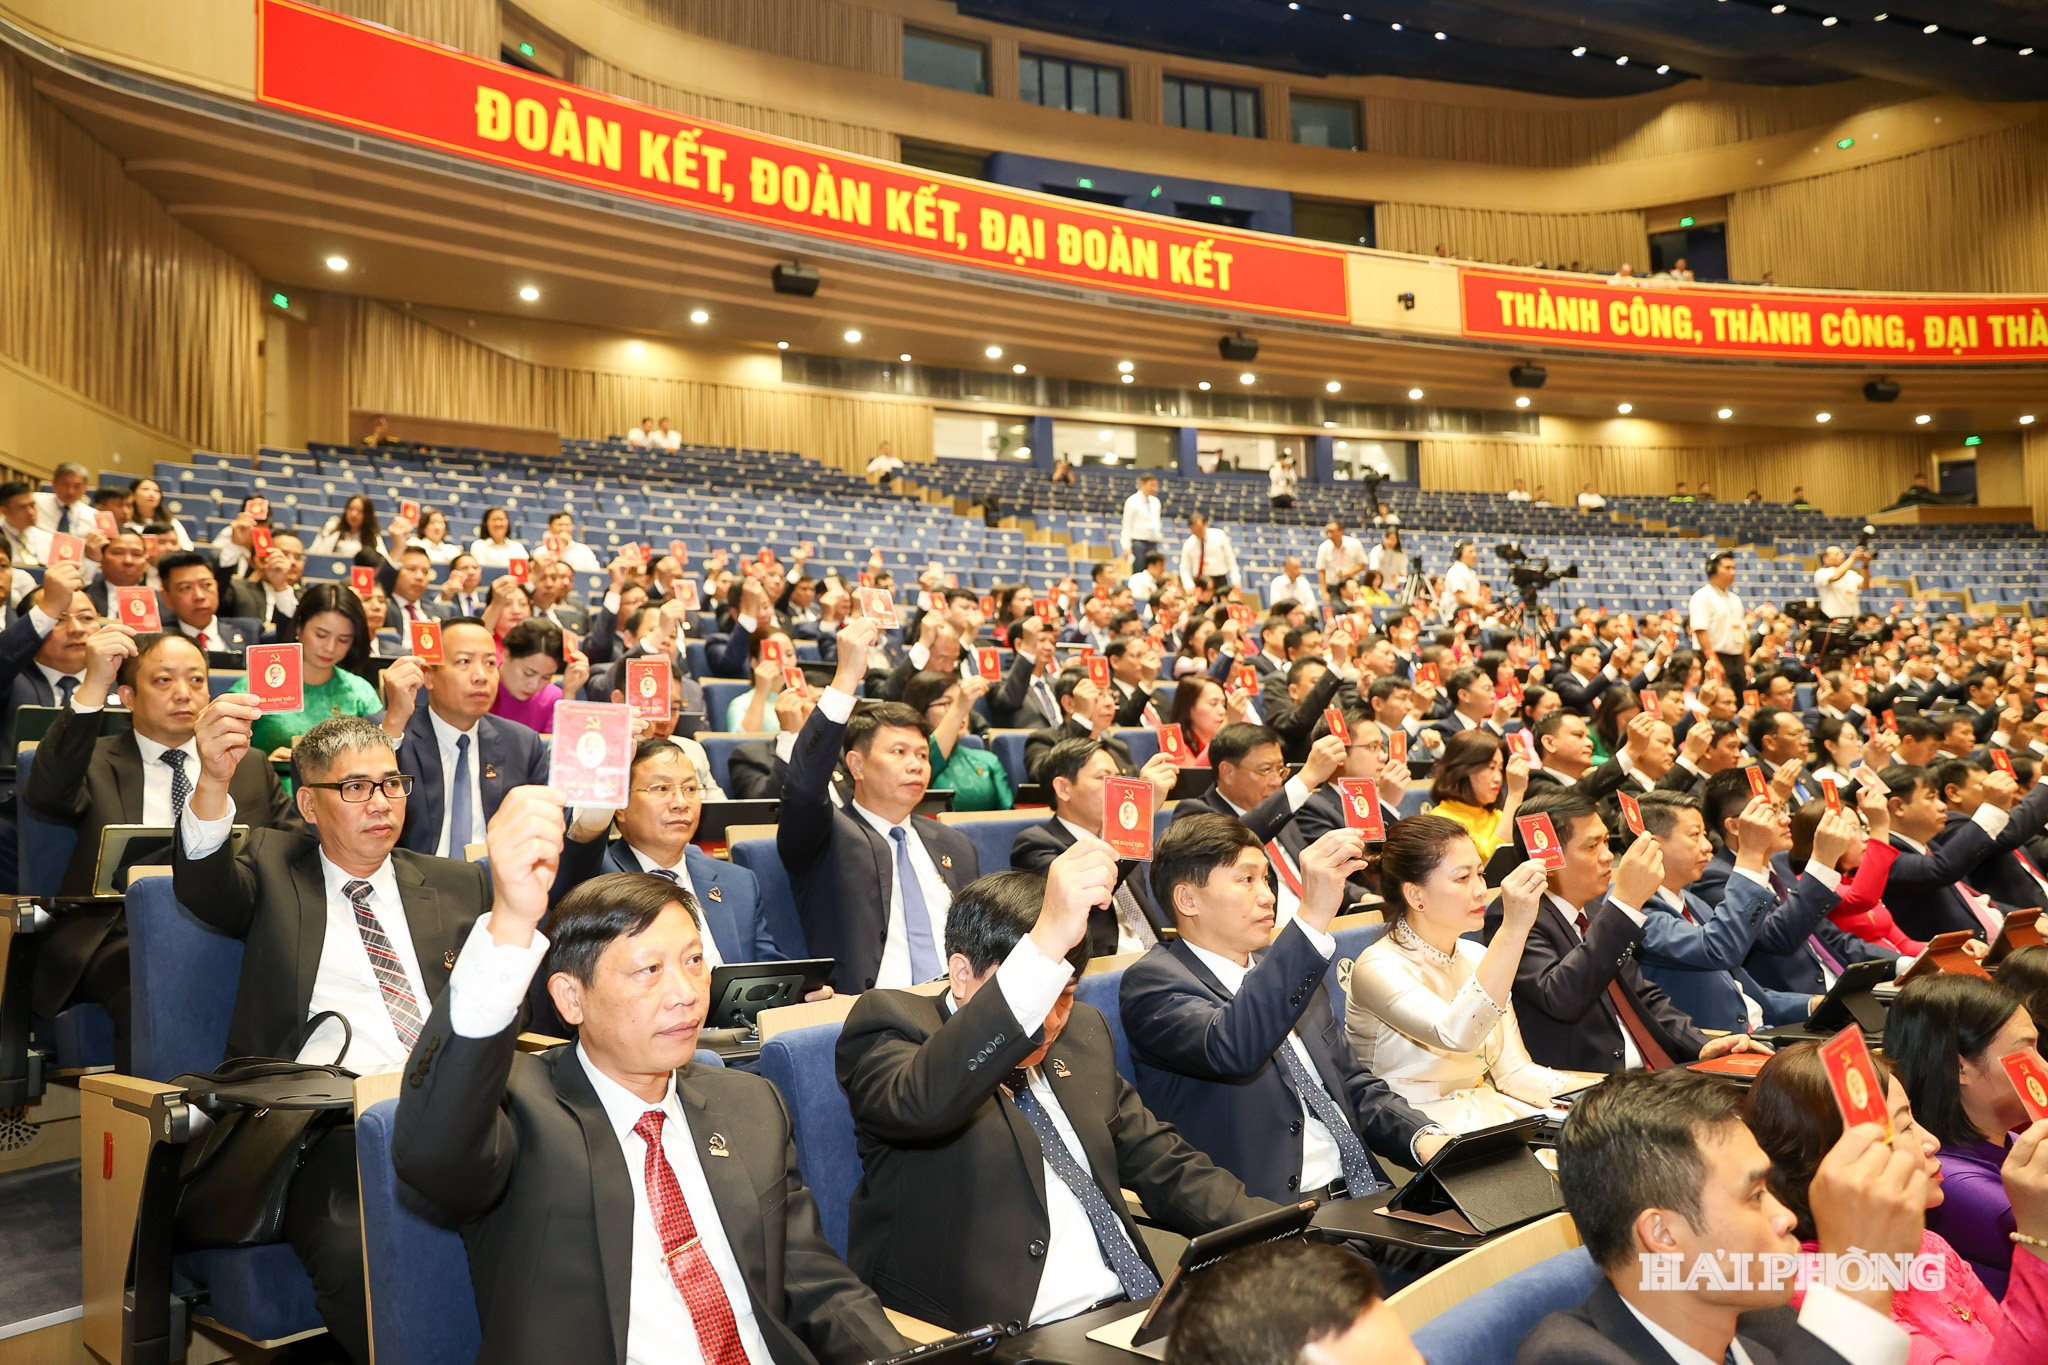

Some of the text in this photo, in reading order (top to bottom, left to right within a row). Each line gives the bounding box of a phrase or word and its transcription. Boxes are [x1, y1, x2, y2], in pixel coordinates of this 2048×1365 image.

[474, 85, 1234, 291] ĐOÀN KẾT, ĐOÀN KẾT, ĐẠI ĐOÀN KẾT
[1496, 287, 1601, 334] THÀNH
[1609, 295, 1703, 345] CÔNG,
[1709, 303, 1812, 346] THÀNH
[1820, 307, 1916, 352] CÔNG,
[1923, 315, 1979, 355] ĐẠI
